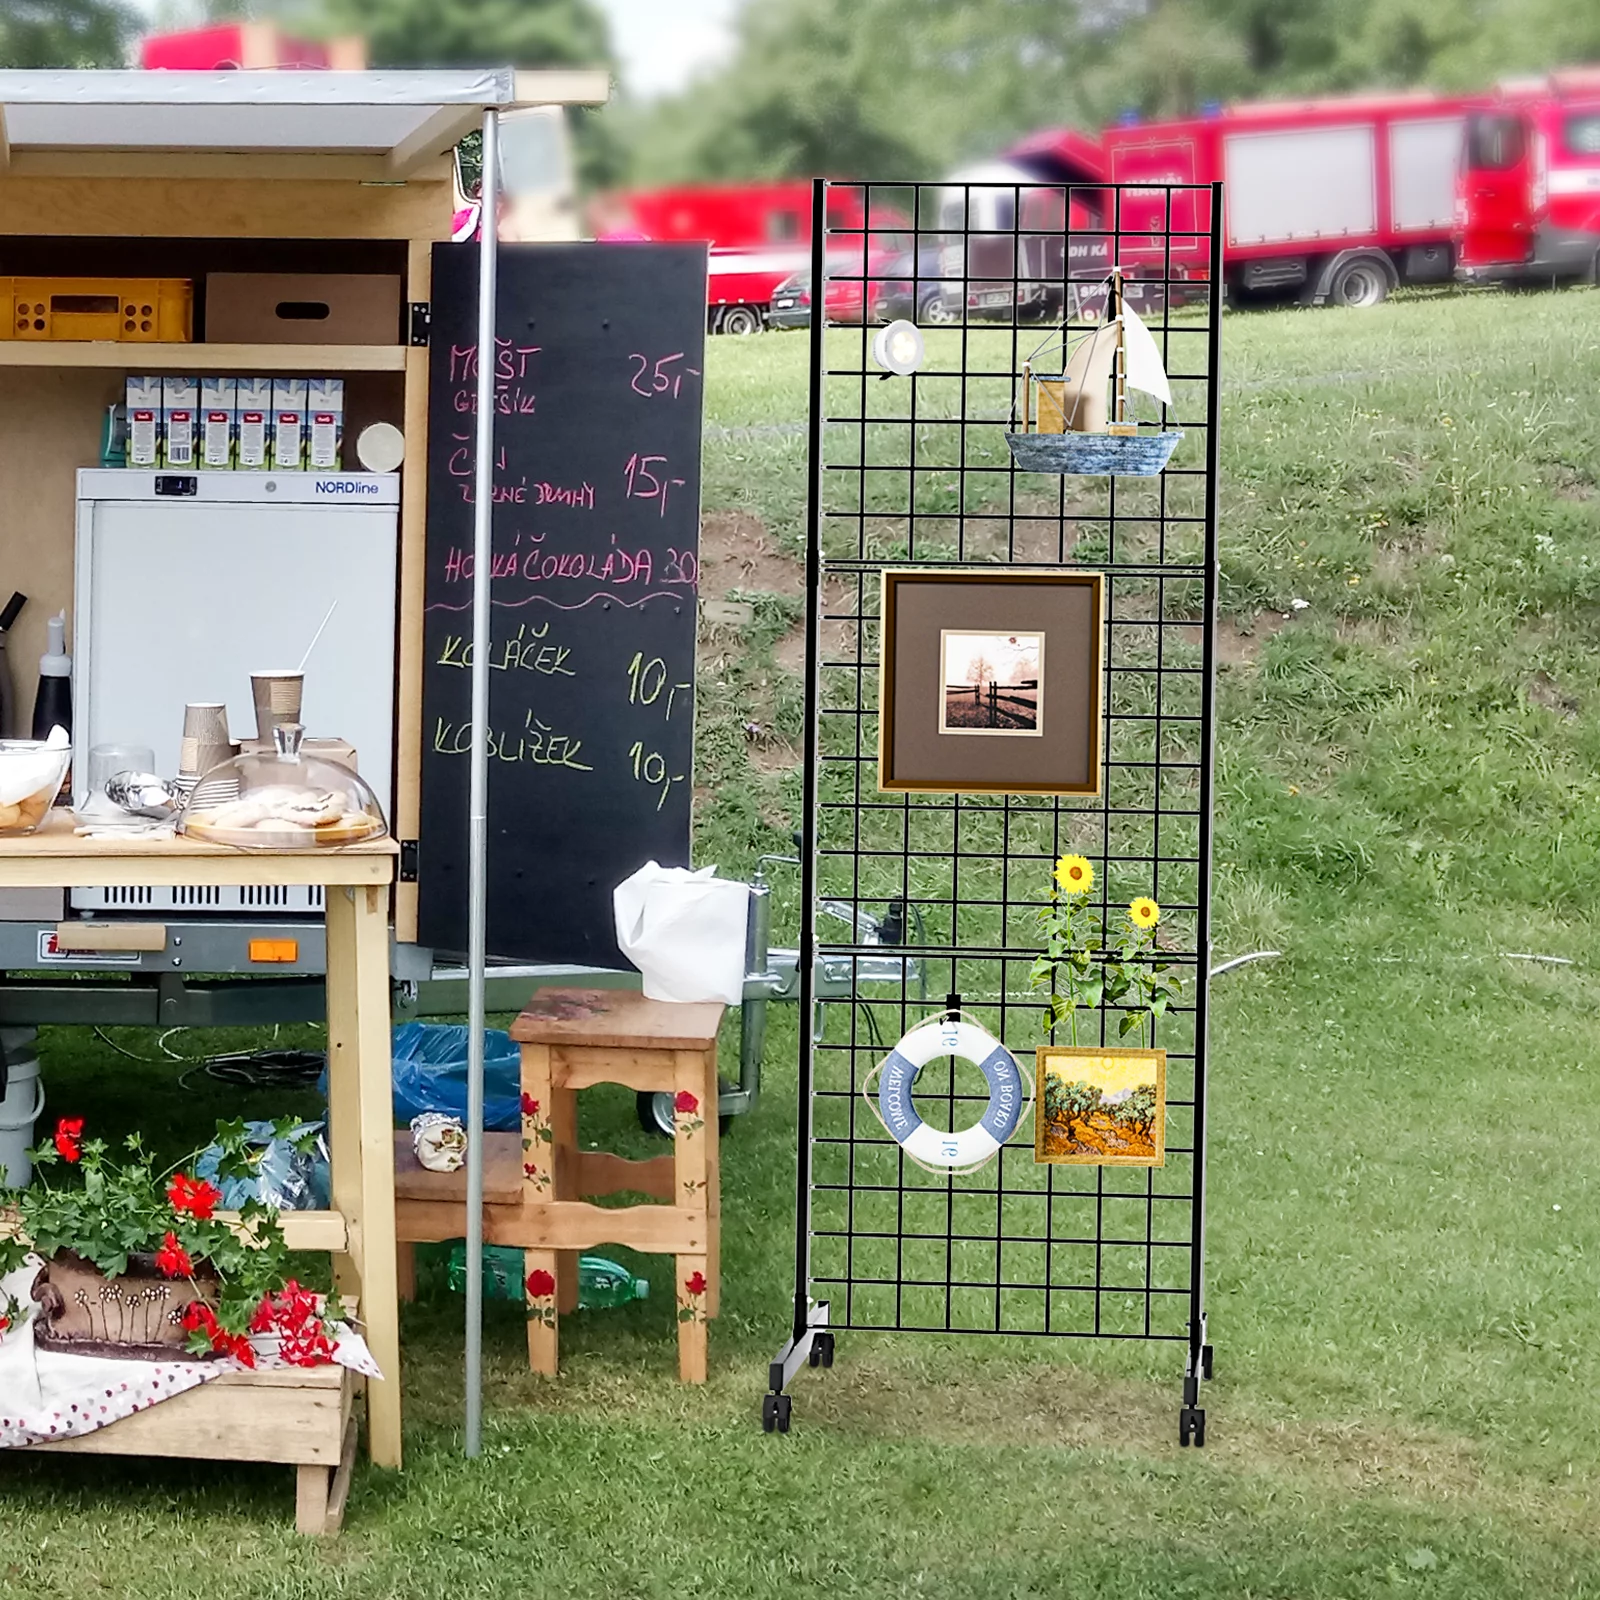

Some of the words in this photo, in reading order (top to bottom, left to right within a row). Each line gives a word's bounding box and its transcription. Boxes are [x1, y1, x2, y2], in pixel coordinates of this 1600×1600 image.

[450, 337, 542, 383] MŠT
[629, 352, 700, 399] 25,-
[315, 480, 380, 495] NORDline
[449, 432, 506, 476] ČJ
[624, 453, 686, 518] 15,-
[444, 529, 519, 583] HOKÁ
[523, 532, 652, 586] ČOKOLÁDA
[628, 651, 692, 721] 10,-
[629, 741, 685, 812] 10,-
